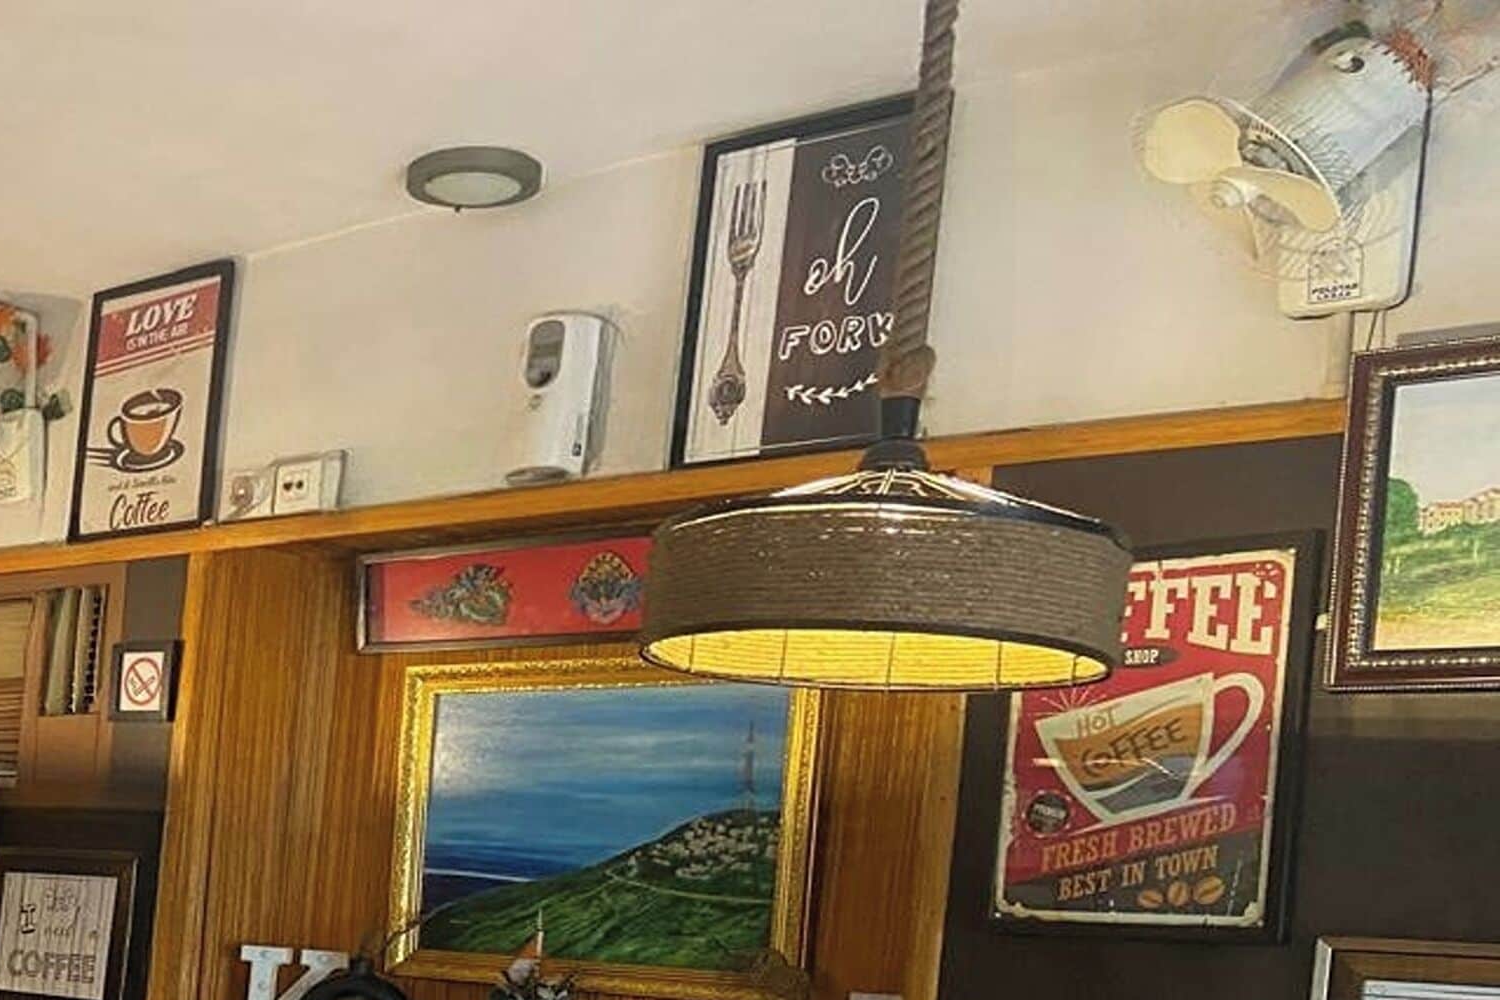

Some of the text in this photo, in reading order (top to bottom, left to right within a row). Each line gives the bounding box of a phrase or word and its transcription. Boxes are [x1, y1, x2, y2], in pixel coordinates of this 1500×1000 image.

[803, 197, 880, 305] oh
[125, 293, 198, 337] LOVE
[778, 311, 895, 361] FORK
[1123, 647, 1160, 666] SHOP
[1075, 705, 1118, 738] HOT
[1080, 718, 1188, 777] COFFEE
[1040, 801, 1237, 871] FRESH BREWED
[1056, 844, 1220, 901] BEST IN TOWN
[7, 948, 97, 985] COFFEE
